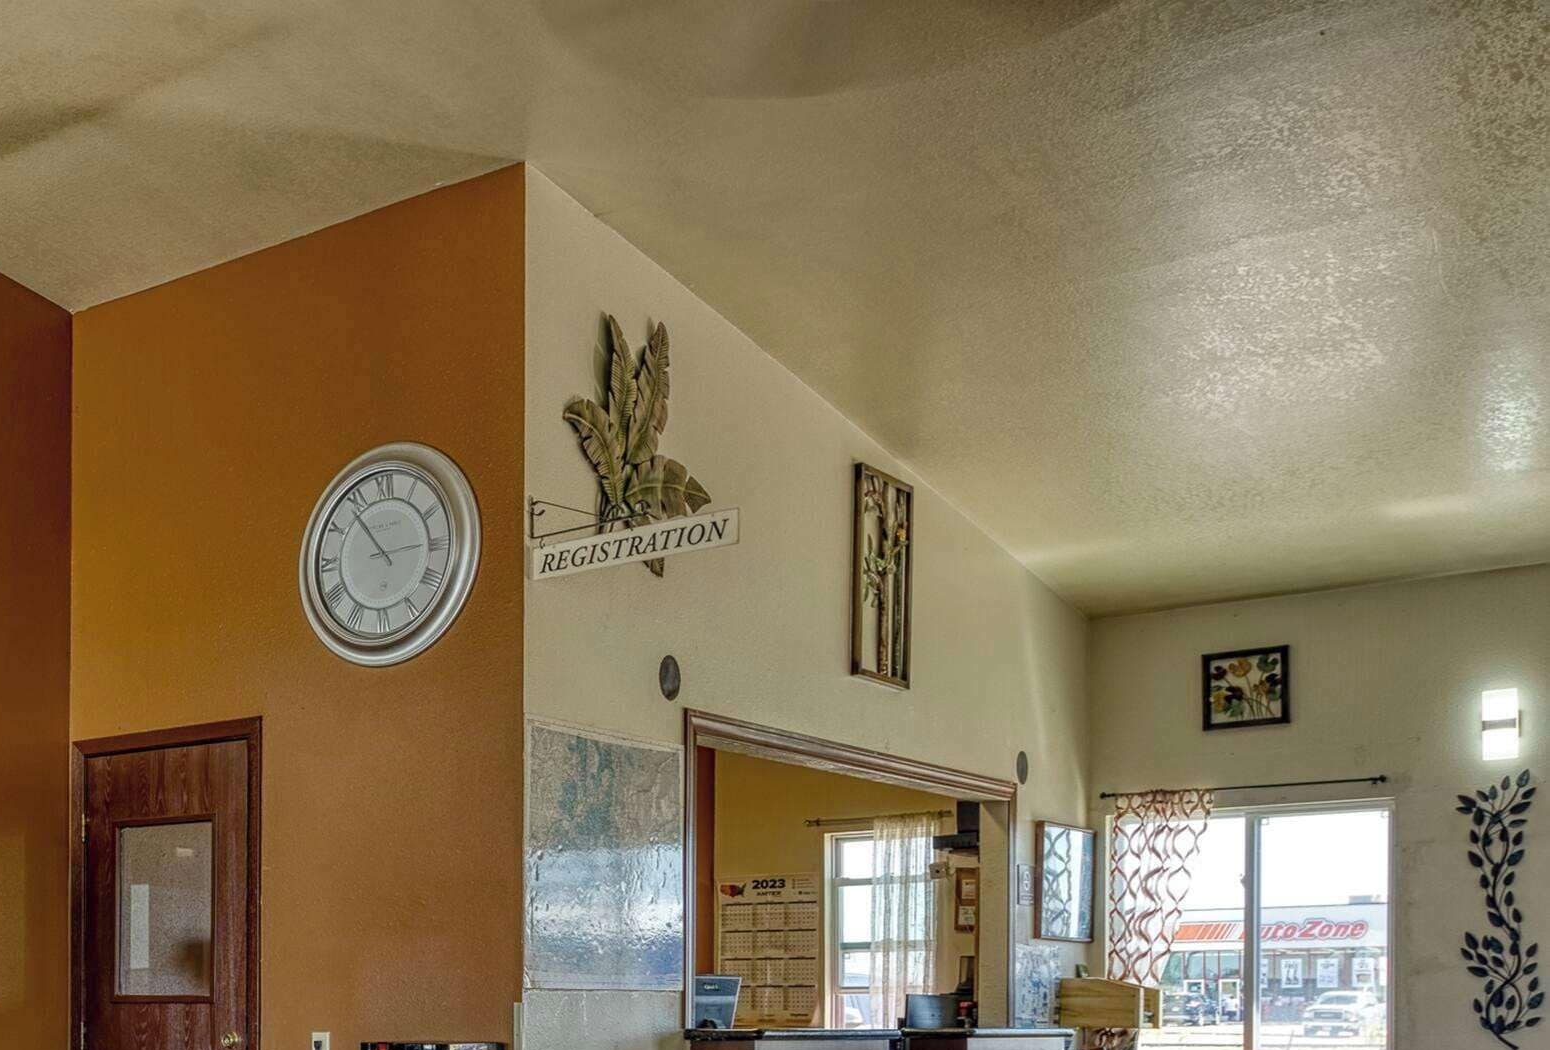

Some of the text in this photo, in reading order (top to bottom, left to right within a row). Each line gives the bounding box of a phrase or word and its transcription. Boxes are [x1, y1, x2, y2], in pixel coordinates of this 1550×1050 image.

[539, 518, 730, 574] REGISTRATION
[752, 879, 786, 889] 2023
[1239, 918, 1367, 941] utoZone
